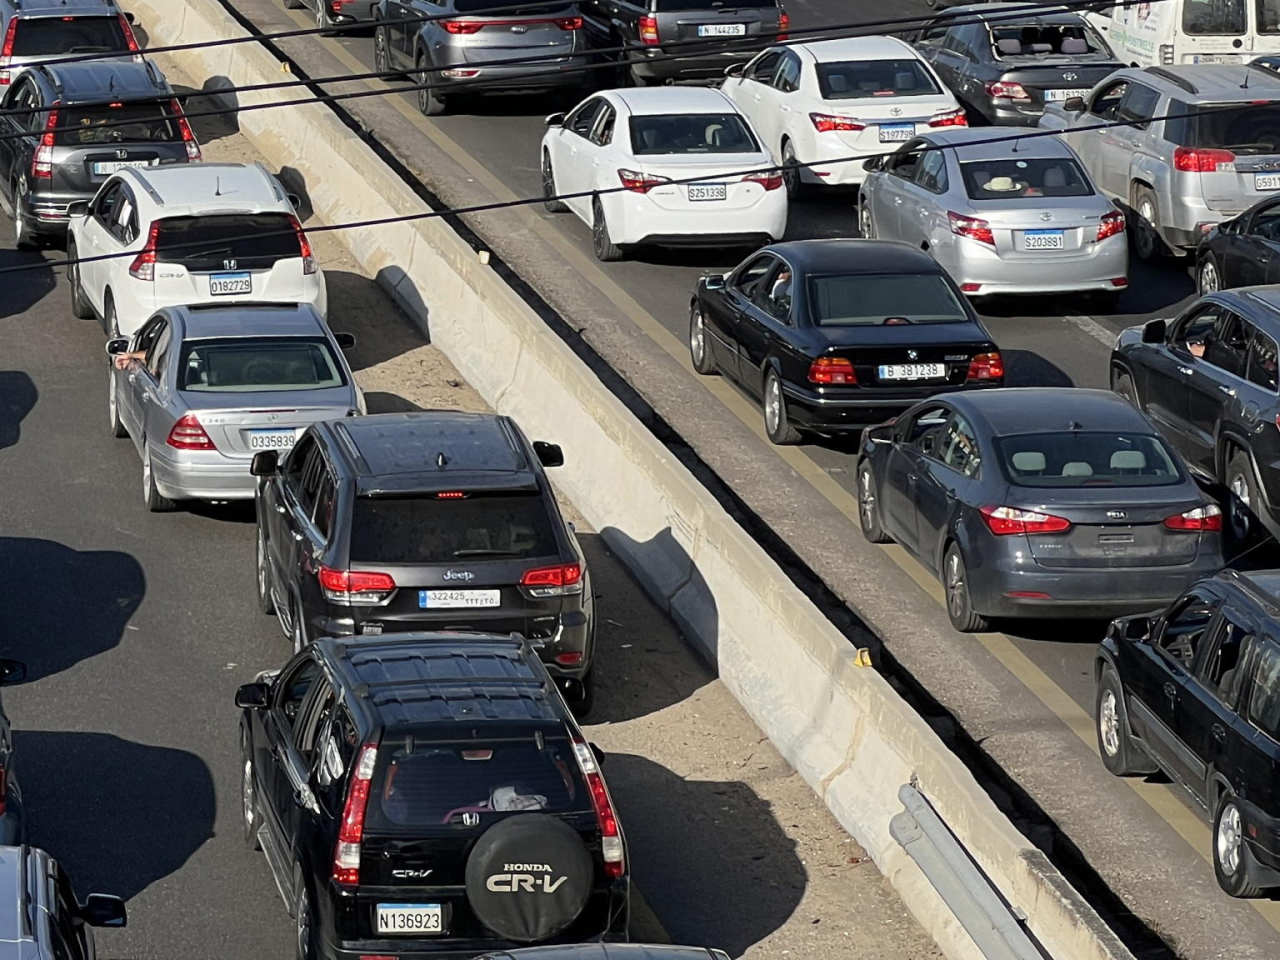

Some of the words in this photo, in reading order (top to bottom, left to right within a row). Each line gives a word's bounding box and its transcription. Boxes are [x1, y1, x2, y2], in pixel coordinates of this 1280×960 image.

[714, 25, 740, 35] 144235
[690, 186, 725, 199] S251338
[1025, 236, 1063, 248] S203881
[444, 570, 474, 581] Jeep
[432, 592, 464, 600] 322425
[503, 863, 552, 872] HONDA
[392, 869, 433, 879] CR-V
[486, 874, 568, 893] CR-V
[379, 913, 440, 930] N136923
